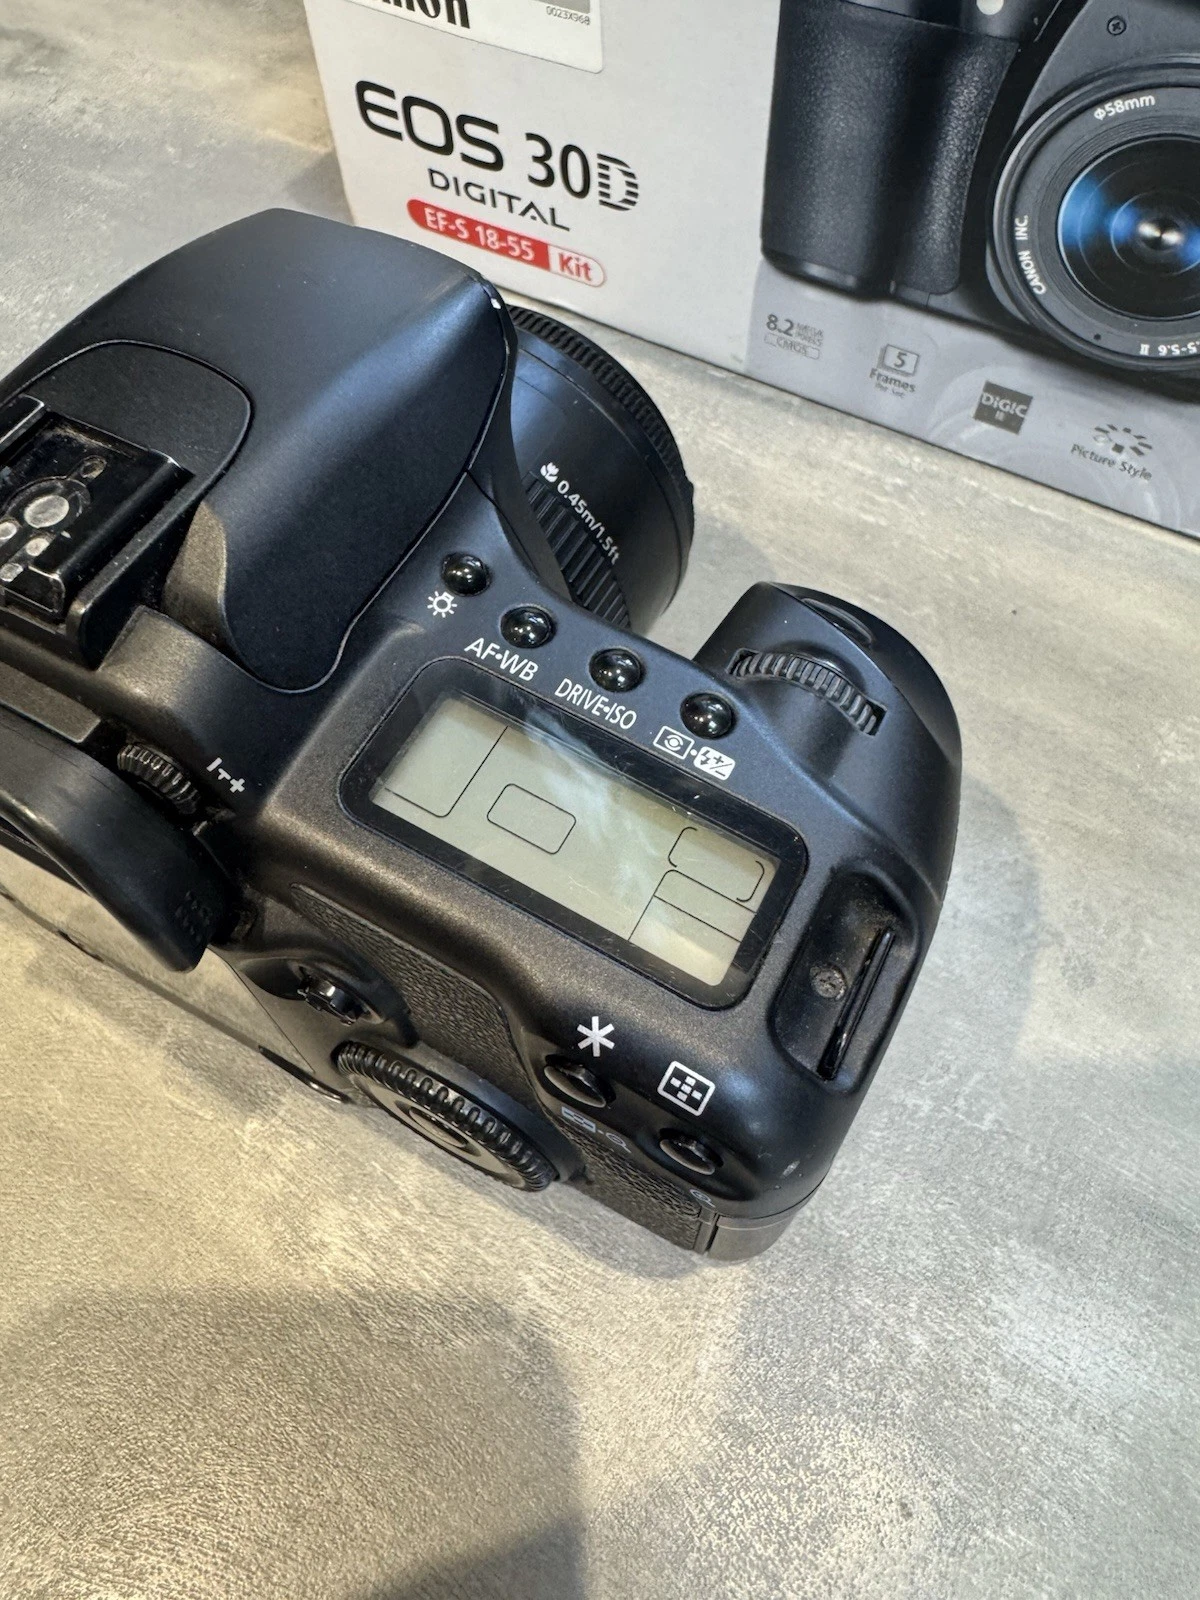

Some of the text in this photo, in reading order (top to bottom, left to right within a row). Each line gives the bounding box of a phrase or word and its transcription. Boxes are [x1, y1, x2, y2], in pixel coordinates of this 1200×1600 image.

[355, 80, 639, 211] EOS 30D
[428, 168, 570, 232] DIGITAL
[424, 206, 592, 282] EF-S 18-55 Kit
[1015, 214, 1047, 295] CANON INC.
[766, 314, 794, 336] 8.2
[869, 367, 916, 393] Frames
[893, 351, 907, 368] 5
[1070, 443, 1152, 481] Picture Style
[557, 480, 620, 565] 0.45m/1.5ft
